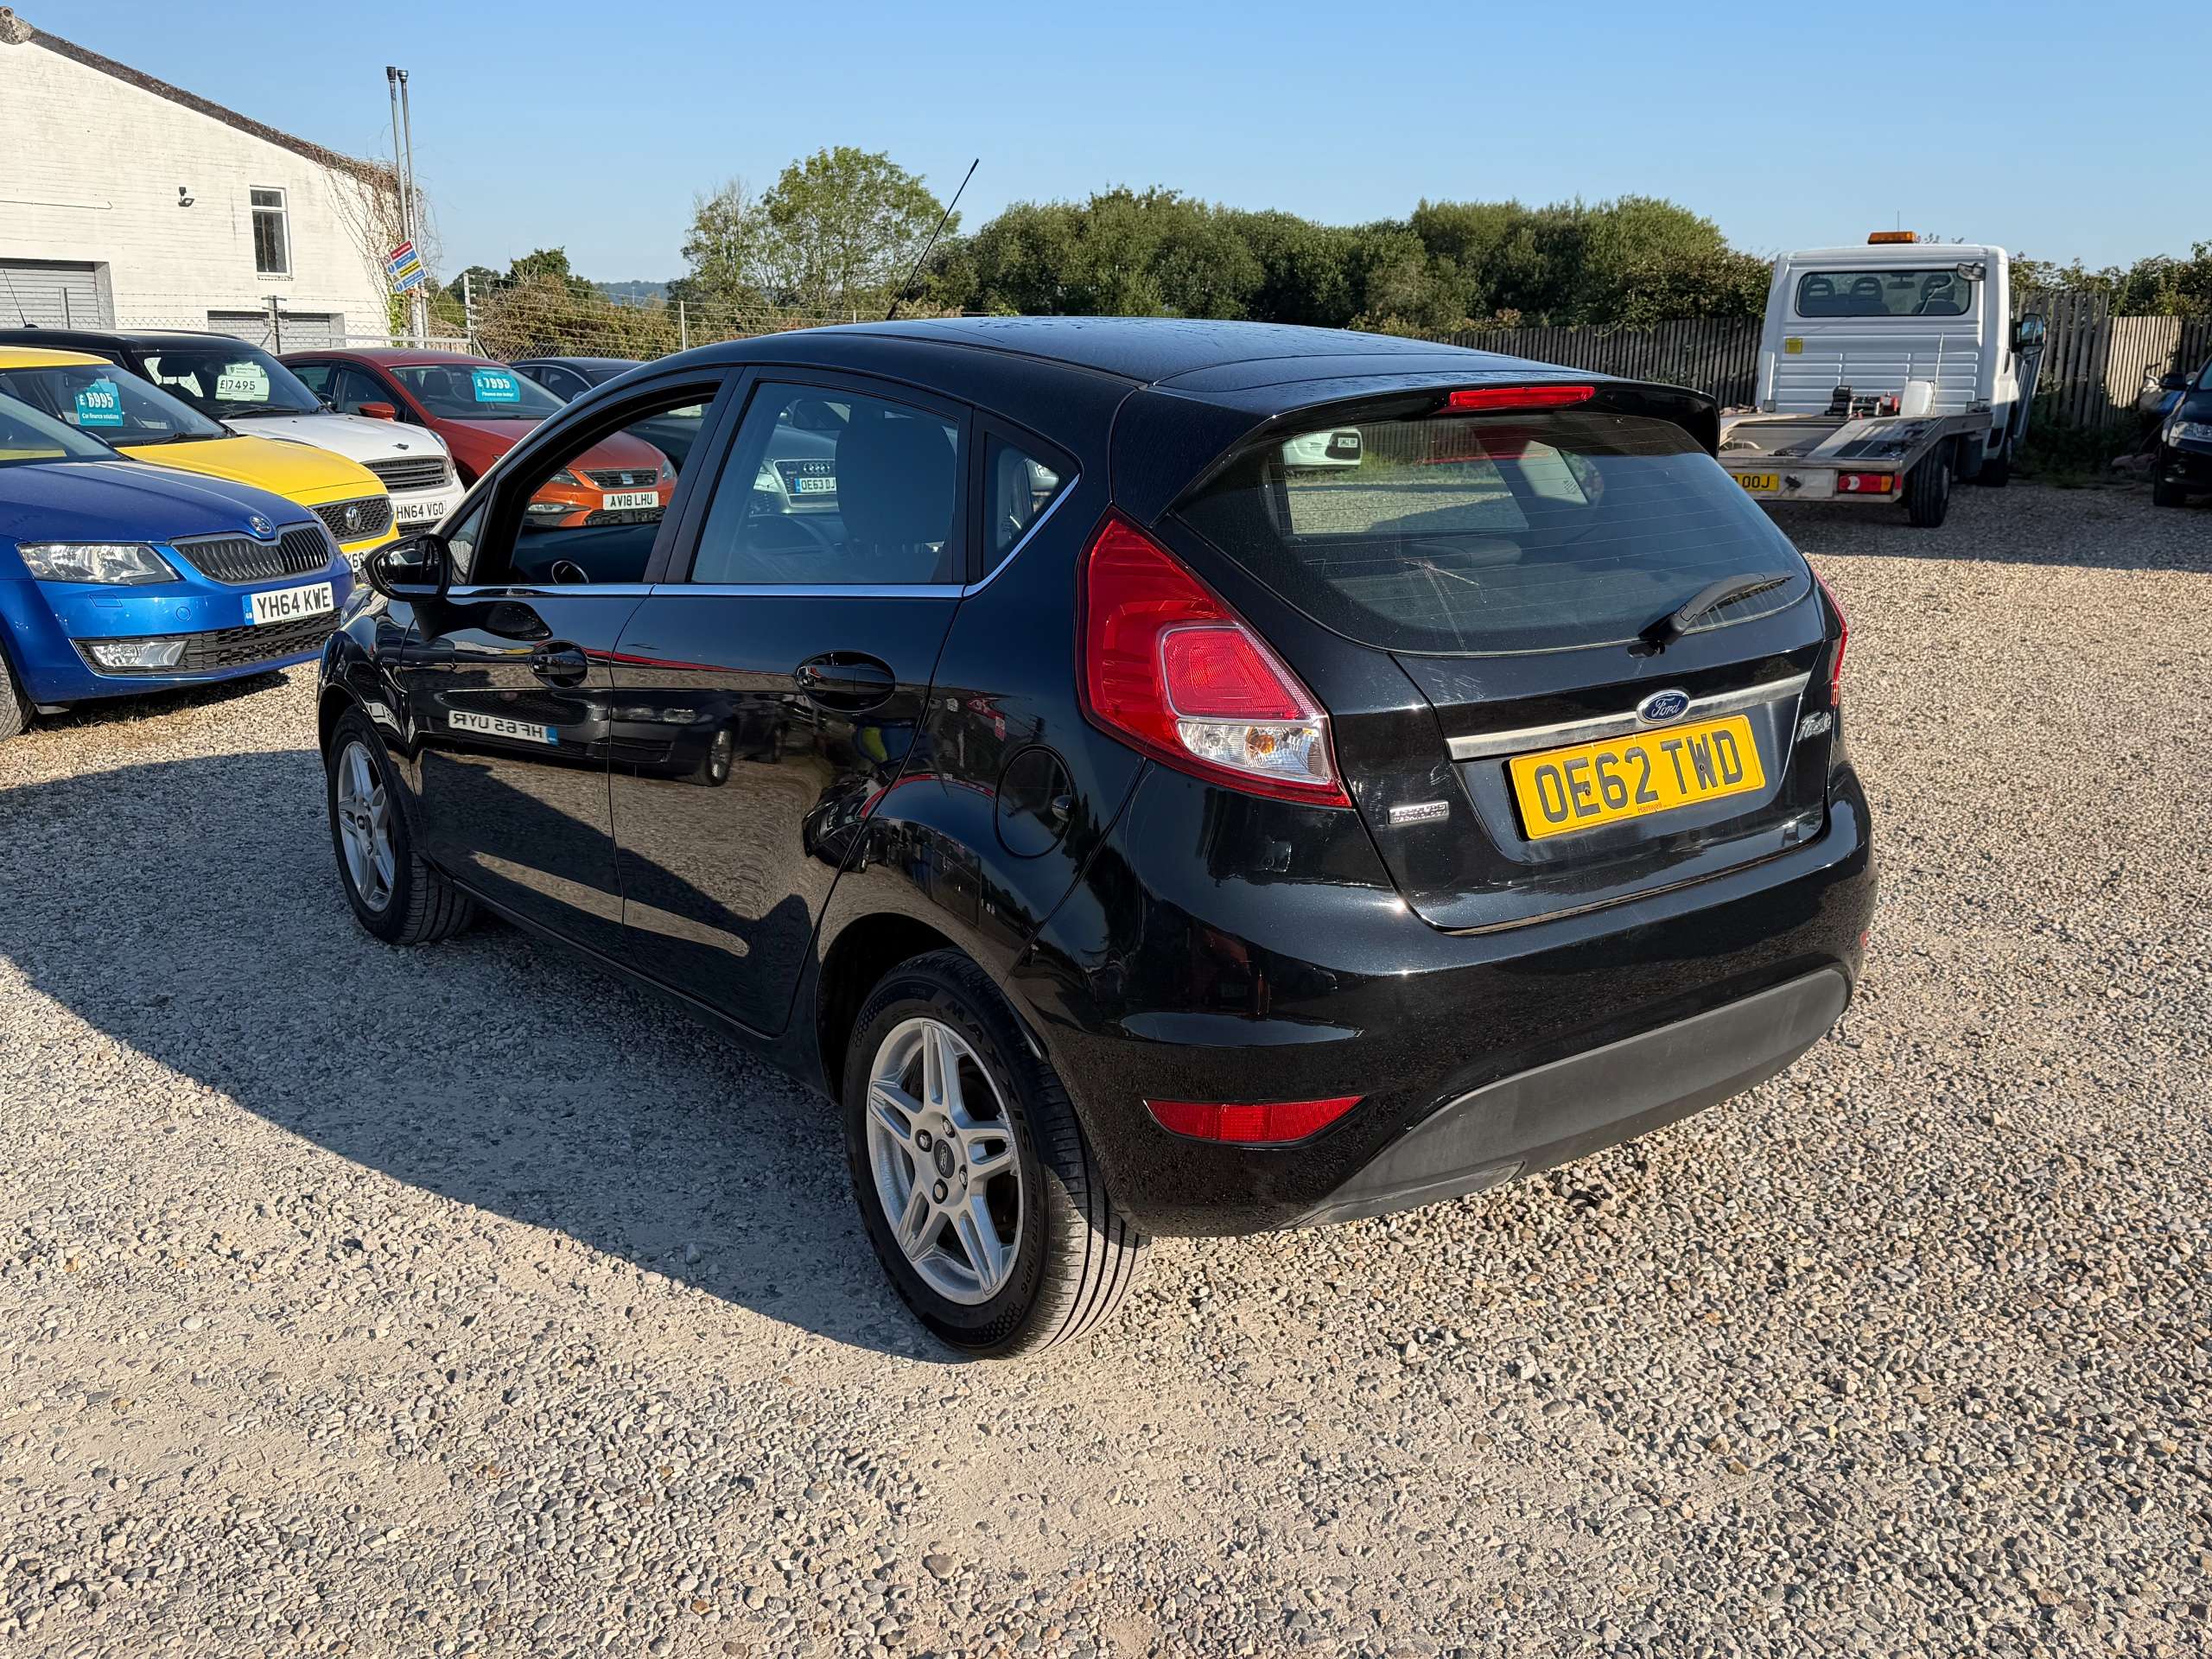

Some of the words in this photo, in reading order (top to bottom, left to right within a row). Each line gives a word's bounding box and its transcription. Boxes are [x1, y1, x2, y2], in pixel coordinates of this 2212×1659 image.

[801, 480, 823, 491] OE63
[610, 495, 632, 507] AV18
[634, 493, 653, 505] LHU
[397, 505, 424, 519] HN64
[257, 592, 301, 620] YH64
[303, 587, 331, 612] KWE
[1651, 696, 1681, 718] Ford
[1534, 746, 1659, 824] OE62
[1659, 728, 1744, 796] TWD
